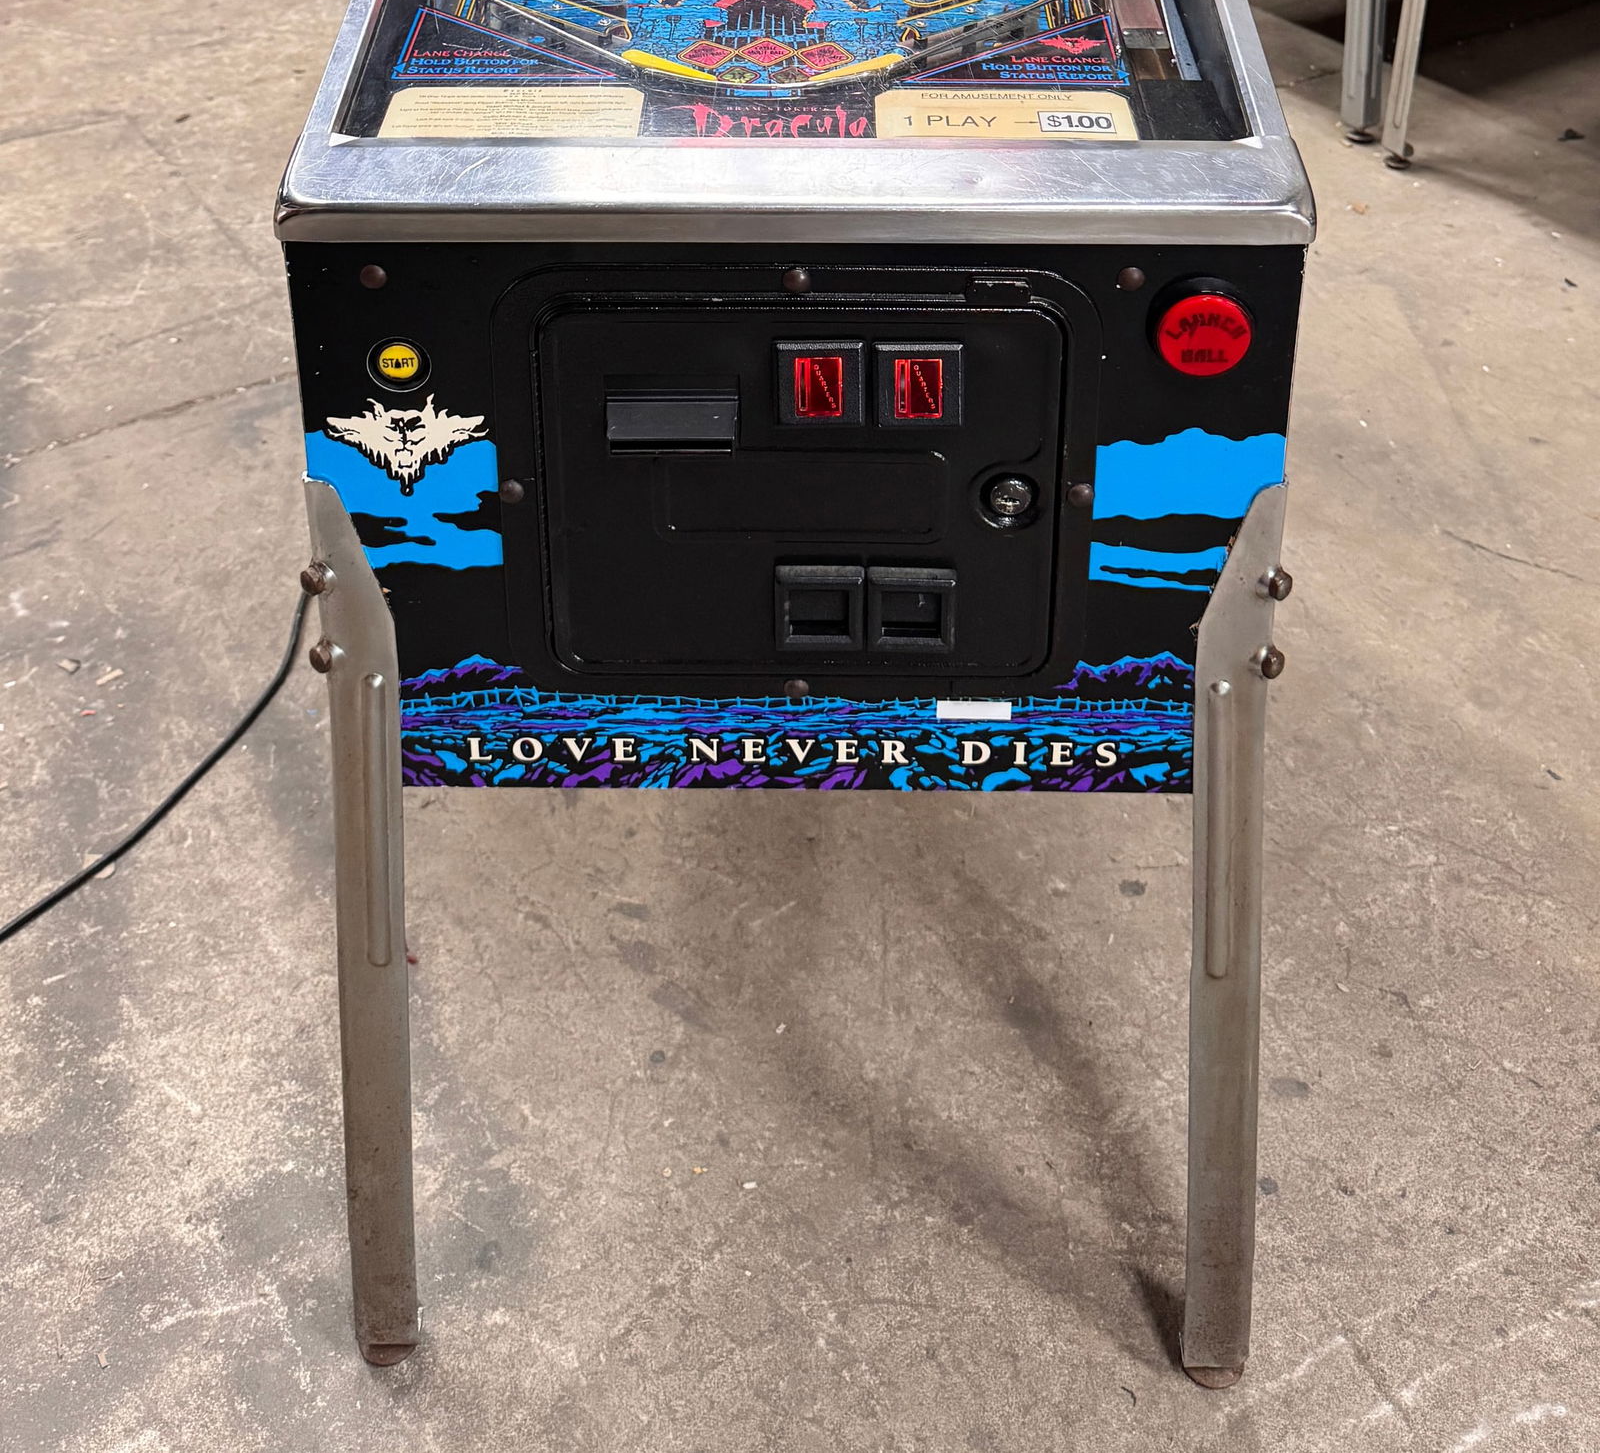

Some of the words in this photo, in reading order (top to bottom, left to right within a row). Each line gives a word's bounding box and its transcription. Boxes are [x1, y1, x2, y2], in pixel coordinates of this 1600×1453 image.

[413, 49, 450, 57] LANE
[453, 49, 511, 58] CHANGE
[1011, 55, 1049, 63] LANE
[1052, 55, 1108, 64] CHANGE
[410, 58, 450, 66] HOLD
[454, 58, 511, 66] BUTTON
[513, 58, 539, 66] FOR
[982, 63, 1022, 71] HOLD
[1026, 63, 1081, 72] BUTTON
[1084, 64, 1112, 72] FOR
[407, 66, 462, 74] STATUS
[465, 66, 521, 74] REPORT
[1000, 71, 1055, 79] STATUS
[1058, 71, 1114, 80] REPORT
[921, 92, 948, 100] FOR
[949, 93, 1035, 101] AMUSEMENT
[1037, 93, 1073, 102] ONLY
[660, 102, 868, 138] Dracula
[904, 115, 912, 126] 1
[927, 115, 997, 128] PLAY
[1047, 115, 1113, 129] $1.00
[1165, 312, 1248, 340] LAUNCH
[1181, 348, 1229, 363] BALL
[382, 357, 415, 369] START
[813, 364, 837, 409] QUARTERS
[913, 364, 936, 410] QUARTERS
[467, 736, 637, 762] LOVE
[690, 737, 909, 764] NEVER
[961, 740, 1119, 767] DIES
